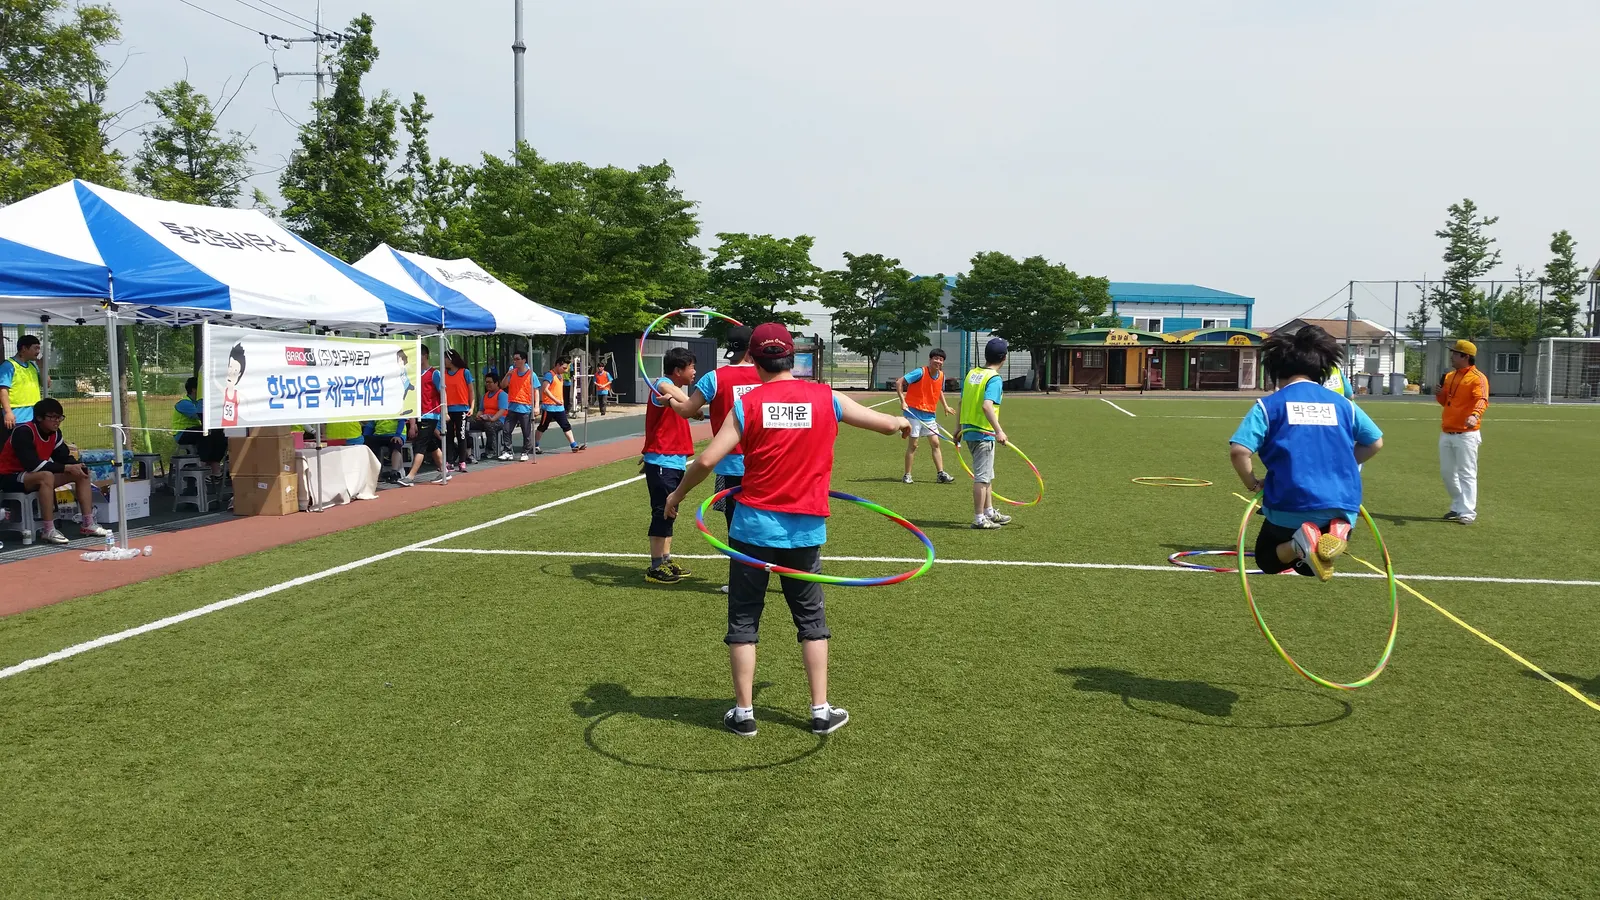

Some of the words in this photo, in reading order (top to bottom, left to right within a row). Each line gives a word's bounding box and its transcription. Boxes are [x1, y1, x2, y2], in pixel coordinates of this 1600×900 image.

[158, 221, 296, 253] 통진읍사무소
[286, 350, 315, 362] BAROCO
[266, 374, 322, 409] 한마음
[326, 375, 385, 408] 체육대회
[225, 404, 233, 417] 56
[768, 405, 808, 421] 임재윤
[1292, 404, 1332, 419] 박은선
